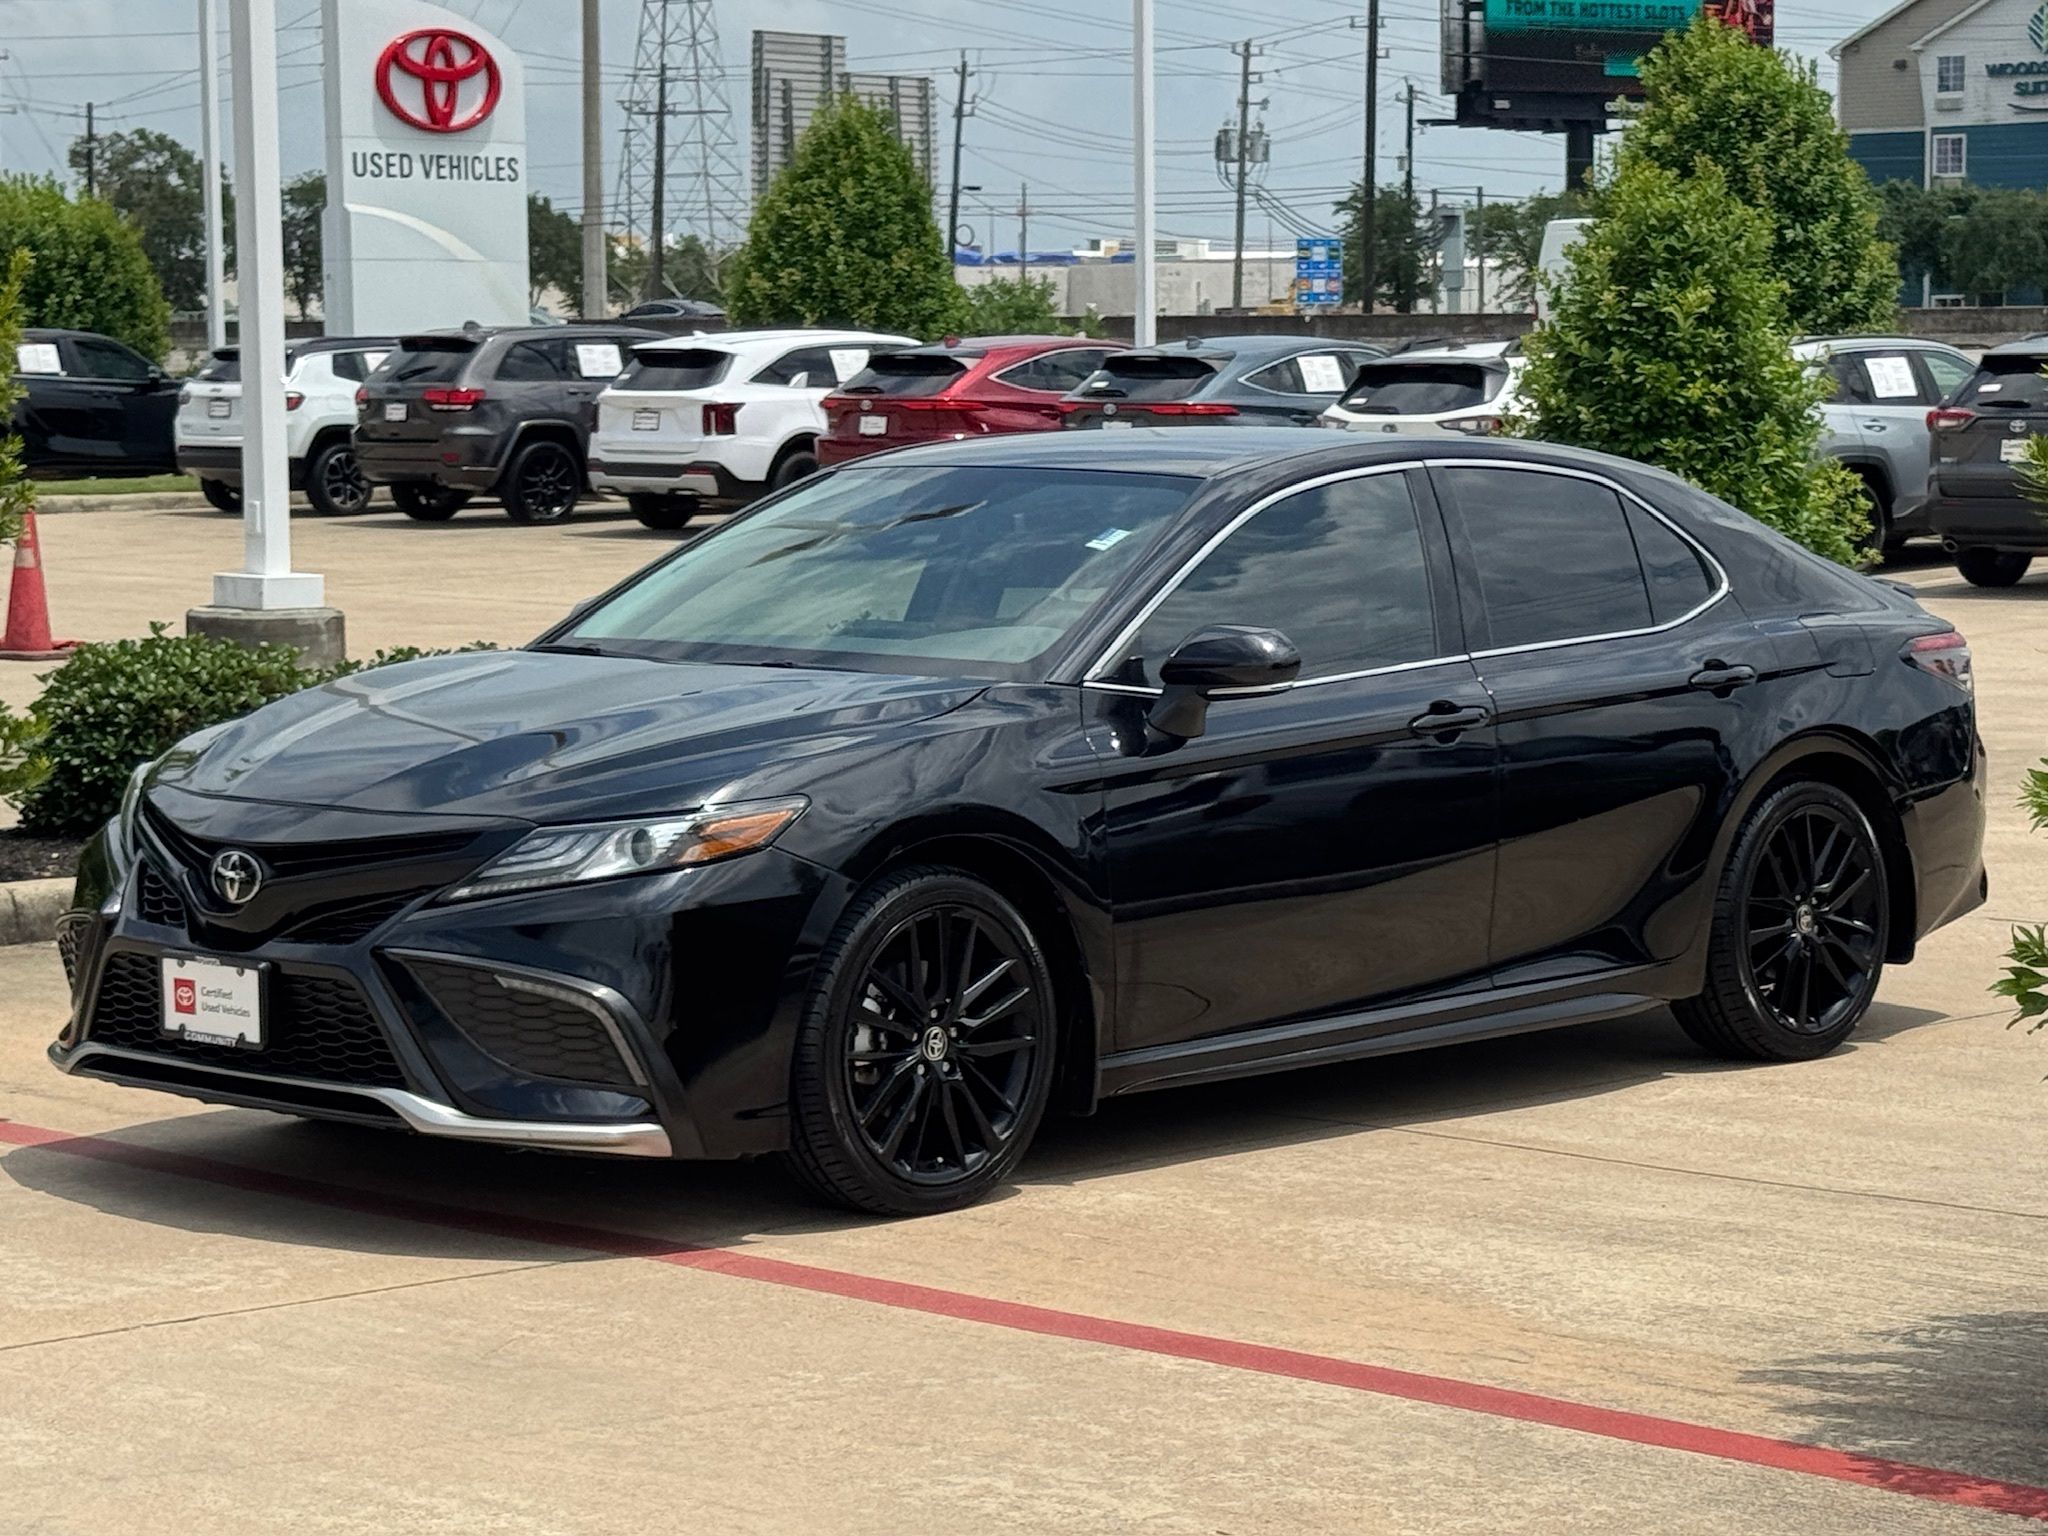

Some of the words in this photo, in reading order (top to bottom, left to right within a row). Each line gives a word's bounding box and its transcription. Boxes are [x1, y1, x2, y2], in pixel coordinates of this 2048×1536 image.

[1506, 0, 1546, 17] FROM
[1549, 1, 1576, 17] THE
[1579, 2, 1642, 19] HOTTEST
[1644, 4, 1685, 21] SLOTS
[352, 151, 413, 178] USED
[420, 153, 519, 182] VEHICLES
[201, 986, 233, 1000] Certified
[202, 1002, 221, 1014] Used
[222, 1004, 251, 1018] Vehicles
